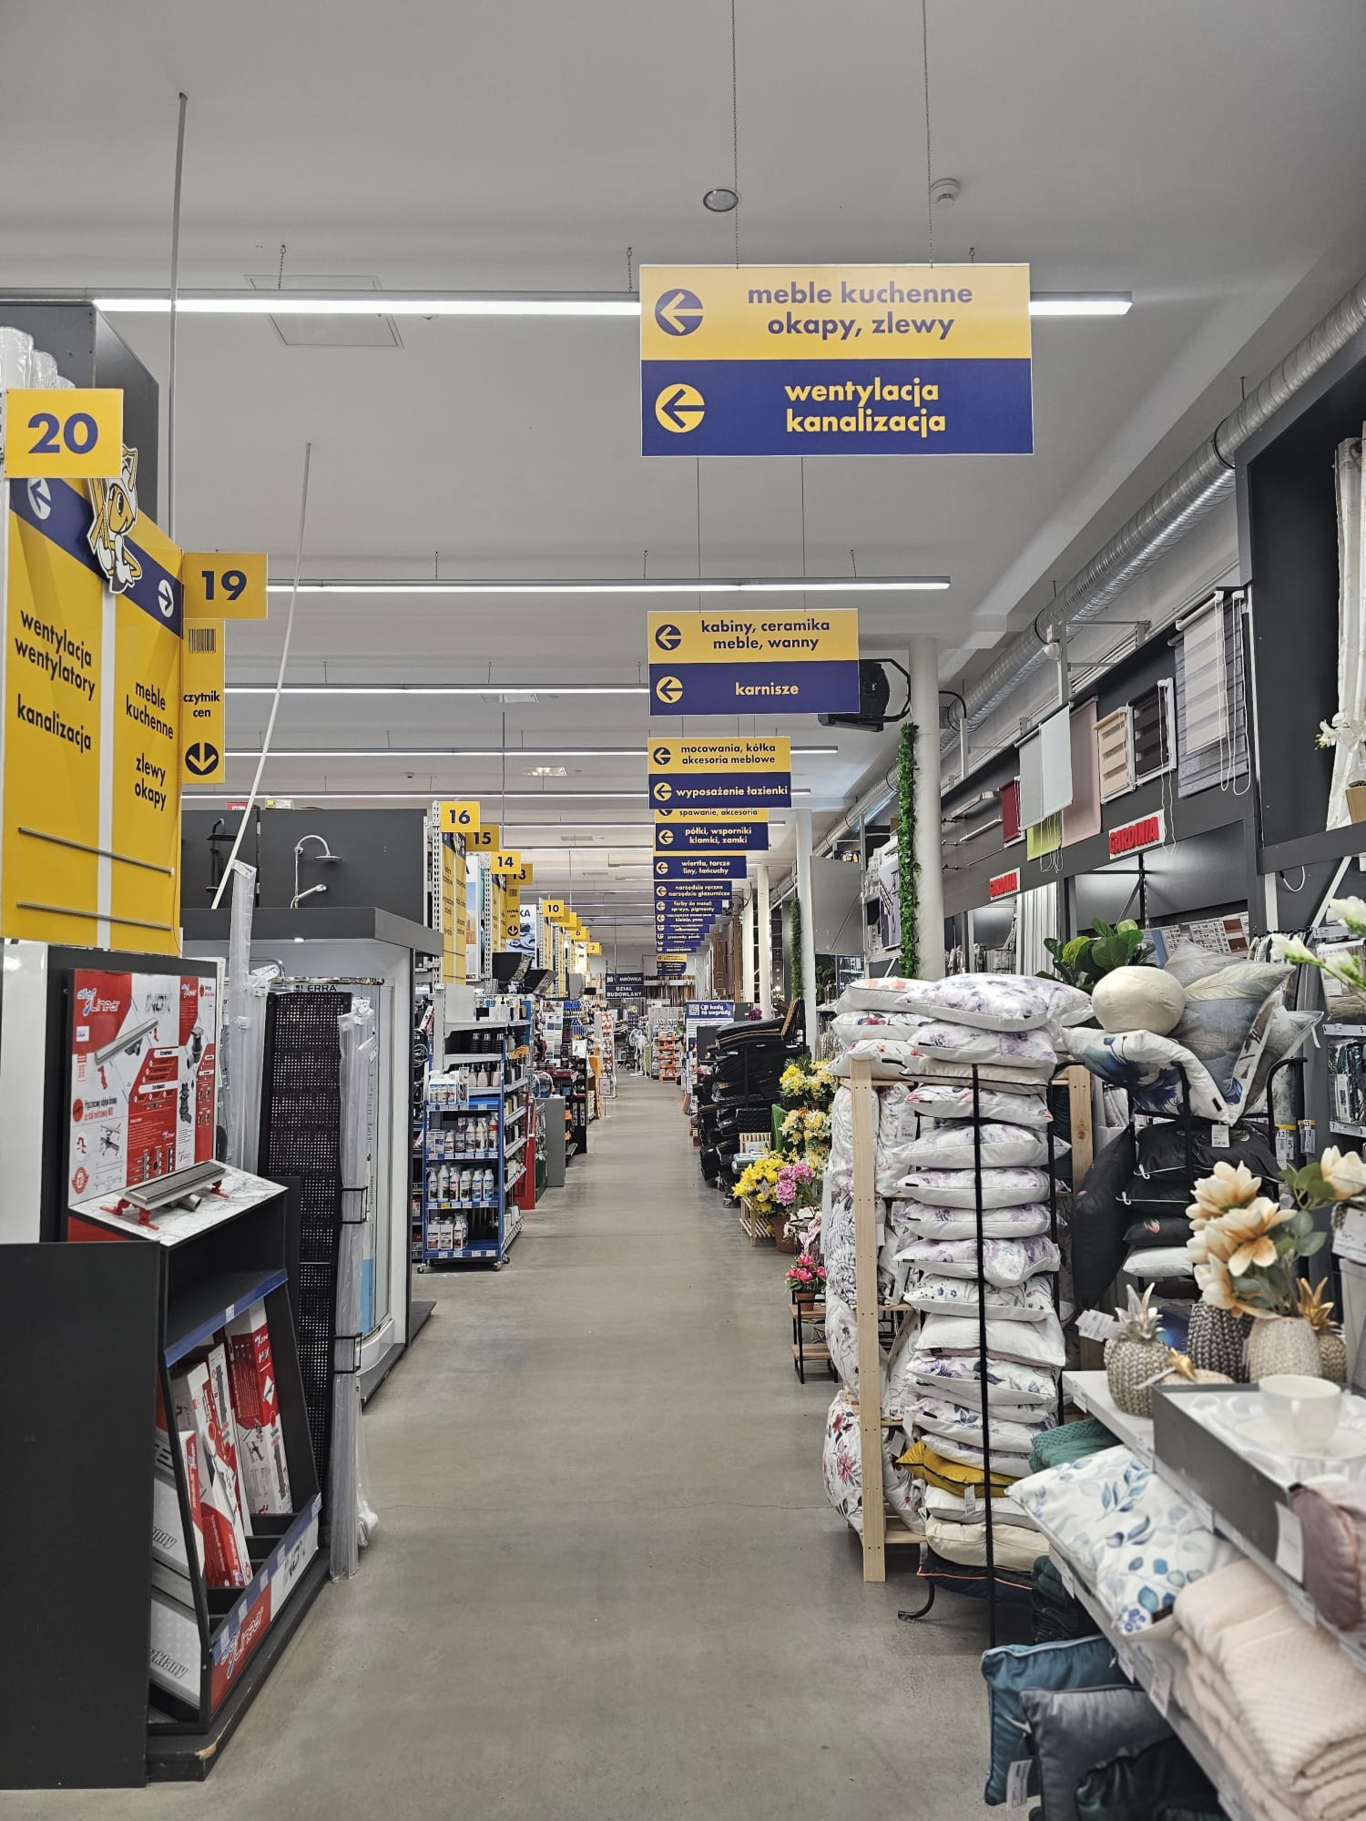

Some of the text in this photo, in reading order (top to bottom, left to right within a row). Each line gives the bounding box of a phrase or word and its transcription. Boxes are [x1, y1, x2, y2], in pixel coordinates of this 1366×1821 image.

[748, 280, 973, 304] meble kuchenne
[767, 311, 955, 340] okapy, zlewy
[784, 377, 939, 408] wentylacja
[786, 408, 946, 438] kanalizacja
[28, 412, 98, 454] 20
[201, 570, 247, 600] 19
[701, 618, 830, 635] kabiny, ceramika
[20, 609, 92, 669] wentylacja
[713, 636, 819, 651] meble, wanny
[15, 637, 95, 701] wentylatory
[135, 681, 166, 711] meble
[735, 682, 799, 696] karnisze
[183, 690, 220, 705] czytnik
[125, 694, 174, 740] kuchenne
[192, 709, 211, 718] cen
[17, 693, 91, 753] kanalizacja
[681, 743, 775, 753] mocowania, kółka
[682, 755, 775, 764] akcesoria meblowe
[136, 752, 166, 787] zlewy
[134, 778, 167, 812] okapy
[676, 785, 788, 799] wyposażenie łazienki
[449, 809, 471, 824] 16
[679, 808, 758, 817] spawanie, akcesoria
[474, 832, 492, 845] 15
[685, 827, 752, 836] półki, wsporniki
[1109, 816, 1159, 855] GARDINIA
[689, 836, 748, 844] klamki, zamki
[497, 856, 514, 868] 14
[513, 869, 526, 880] 13
[547, 904, 559, 912] 10
